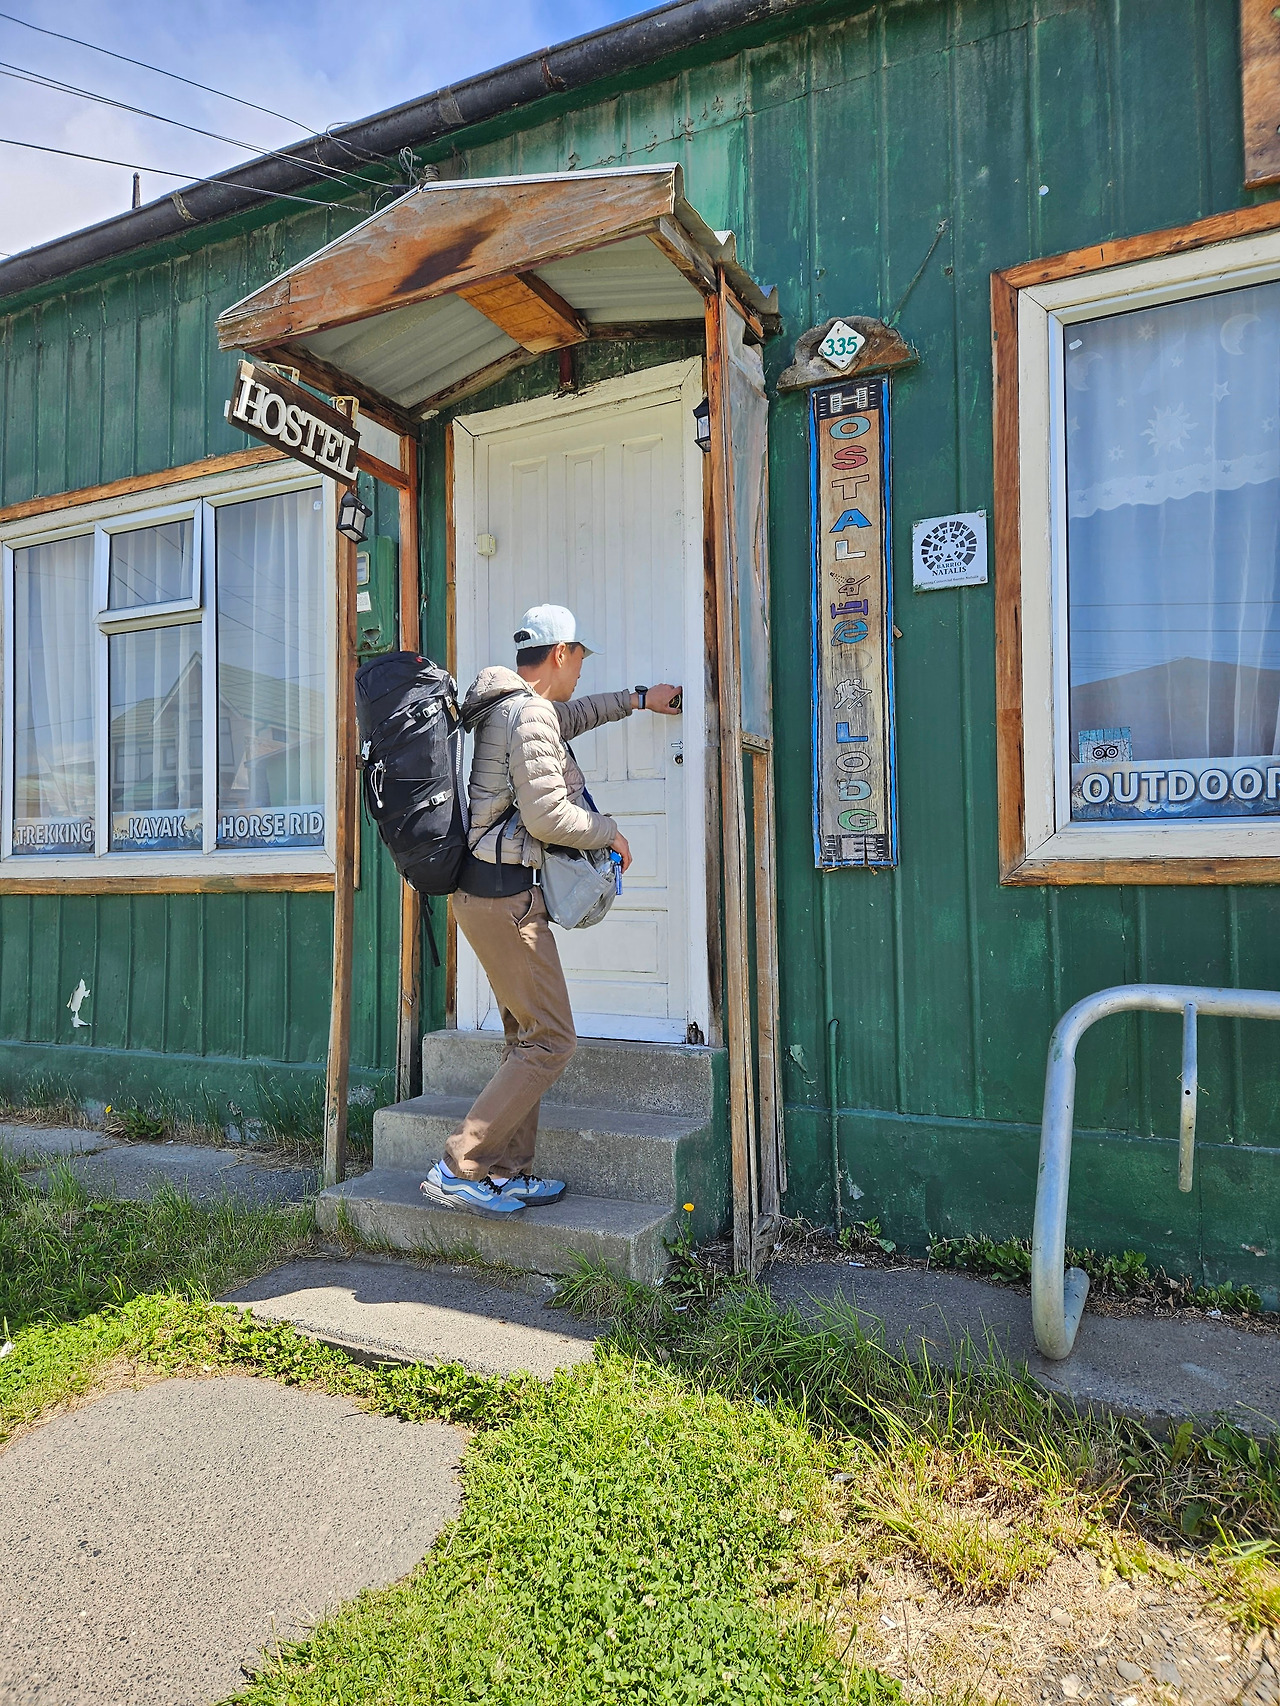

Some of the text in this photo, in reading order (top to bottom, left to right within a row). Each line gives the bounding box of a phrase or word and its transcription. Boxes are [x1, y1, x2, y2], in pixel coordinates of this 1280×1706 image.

[823, 335, 858, 357] 335
[233, 374, 359, 481] HOSTEL
[829, 386, 872, 561] HOSTAL
[932, 566, 967, 576] NATALIS
[936, 561, 962, 570] BARRIO
[836, 721, 878, 860] LODGE
[16, 822, 93, 846] TREKKING
[128, 815, 186, 839] KAYAK
[221, 811, 325, 838] HORSE RID
